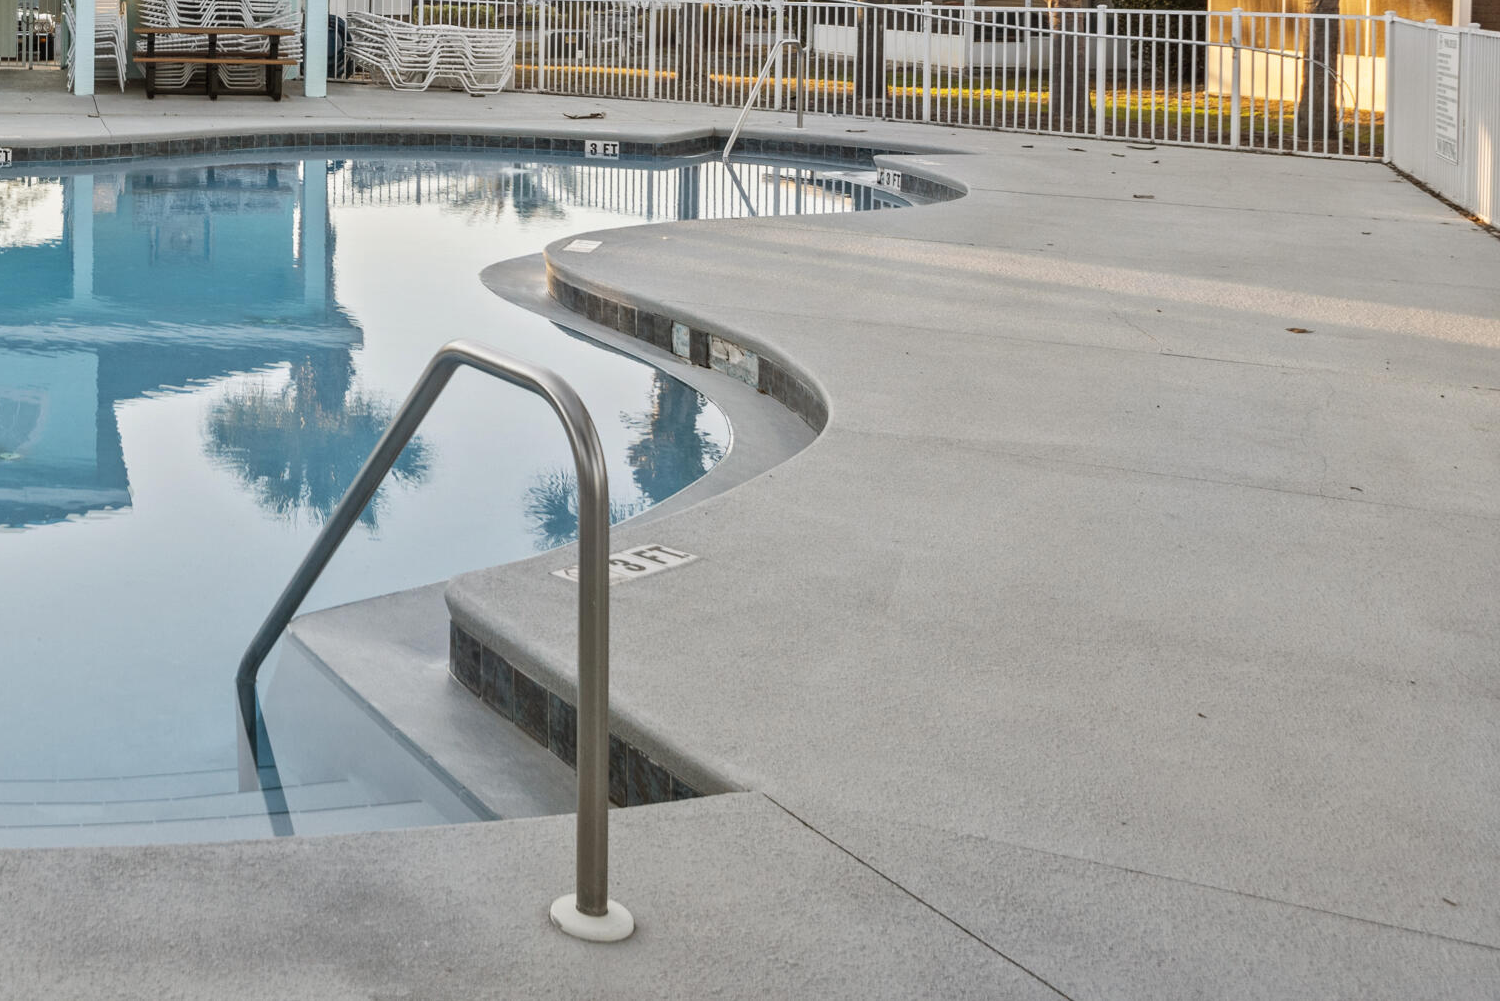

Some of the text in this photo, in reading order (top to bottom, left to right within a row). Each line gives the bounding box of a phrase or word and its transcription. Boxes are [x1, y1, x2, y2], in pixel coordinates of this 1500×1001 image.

[590, 143, 618, 157] 3 FT
[892, 172, 901, 188] FT
[608, 558, 646, 572] 3
